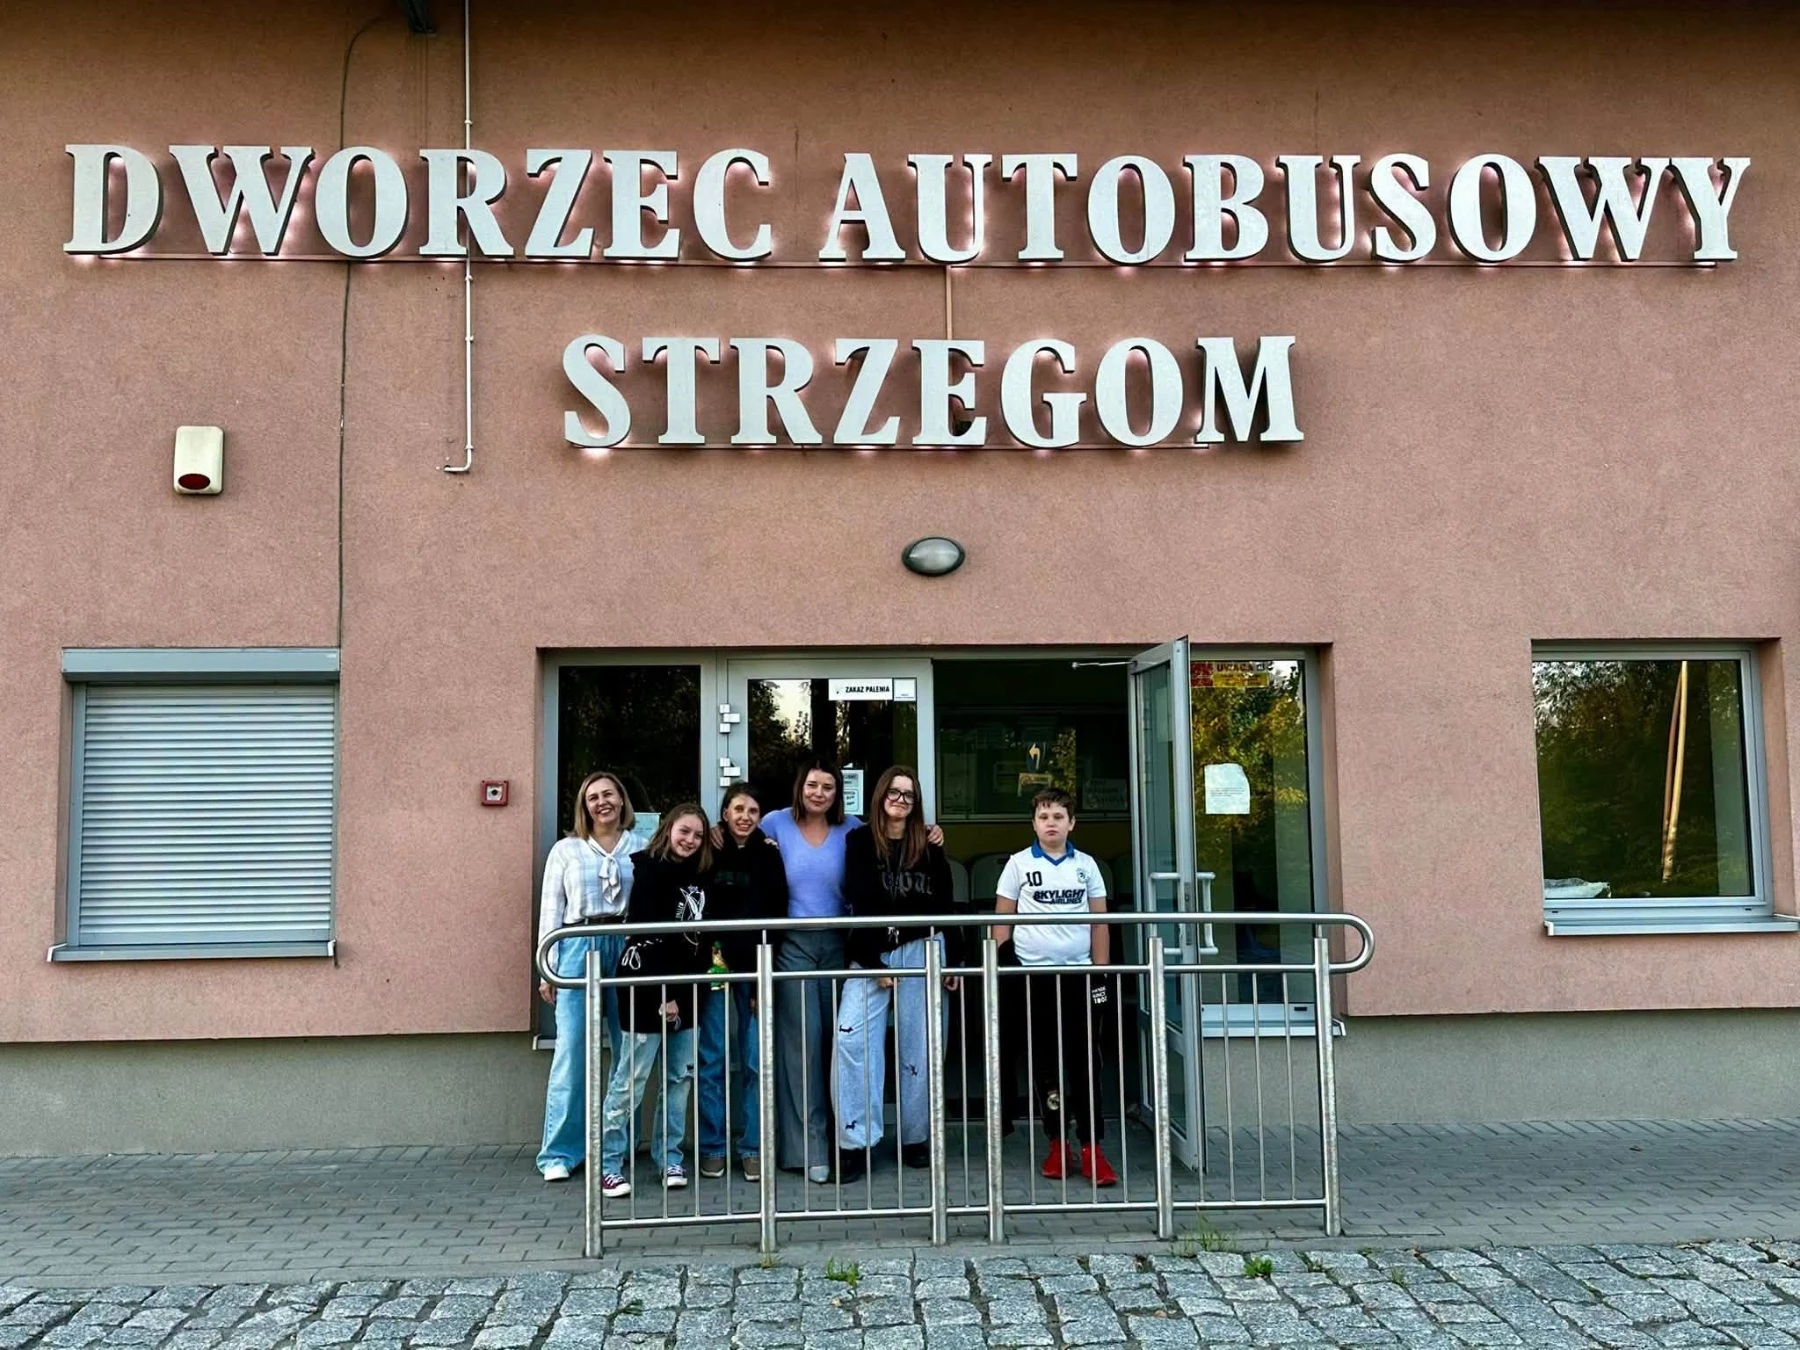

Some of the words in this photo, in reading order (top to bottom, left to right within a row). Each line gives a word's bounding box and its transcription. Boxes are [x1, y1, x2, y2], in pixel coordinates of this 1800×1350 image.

[63, 143, 776, 262] DWORZEC
[818, 152, 1752, 265] AUTOBUSOWY
[563, 334, 1306, 450] STRZEGOM
[845, 686, 864, 694] ZAKAZ
[865, 685, 890, 693] PALENIA
[1025, 870, 1043, 886] 10
[1033, 889, 1086, 900] SKYLIGHT
